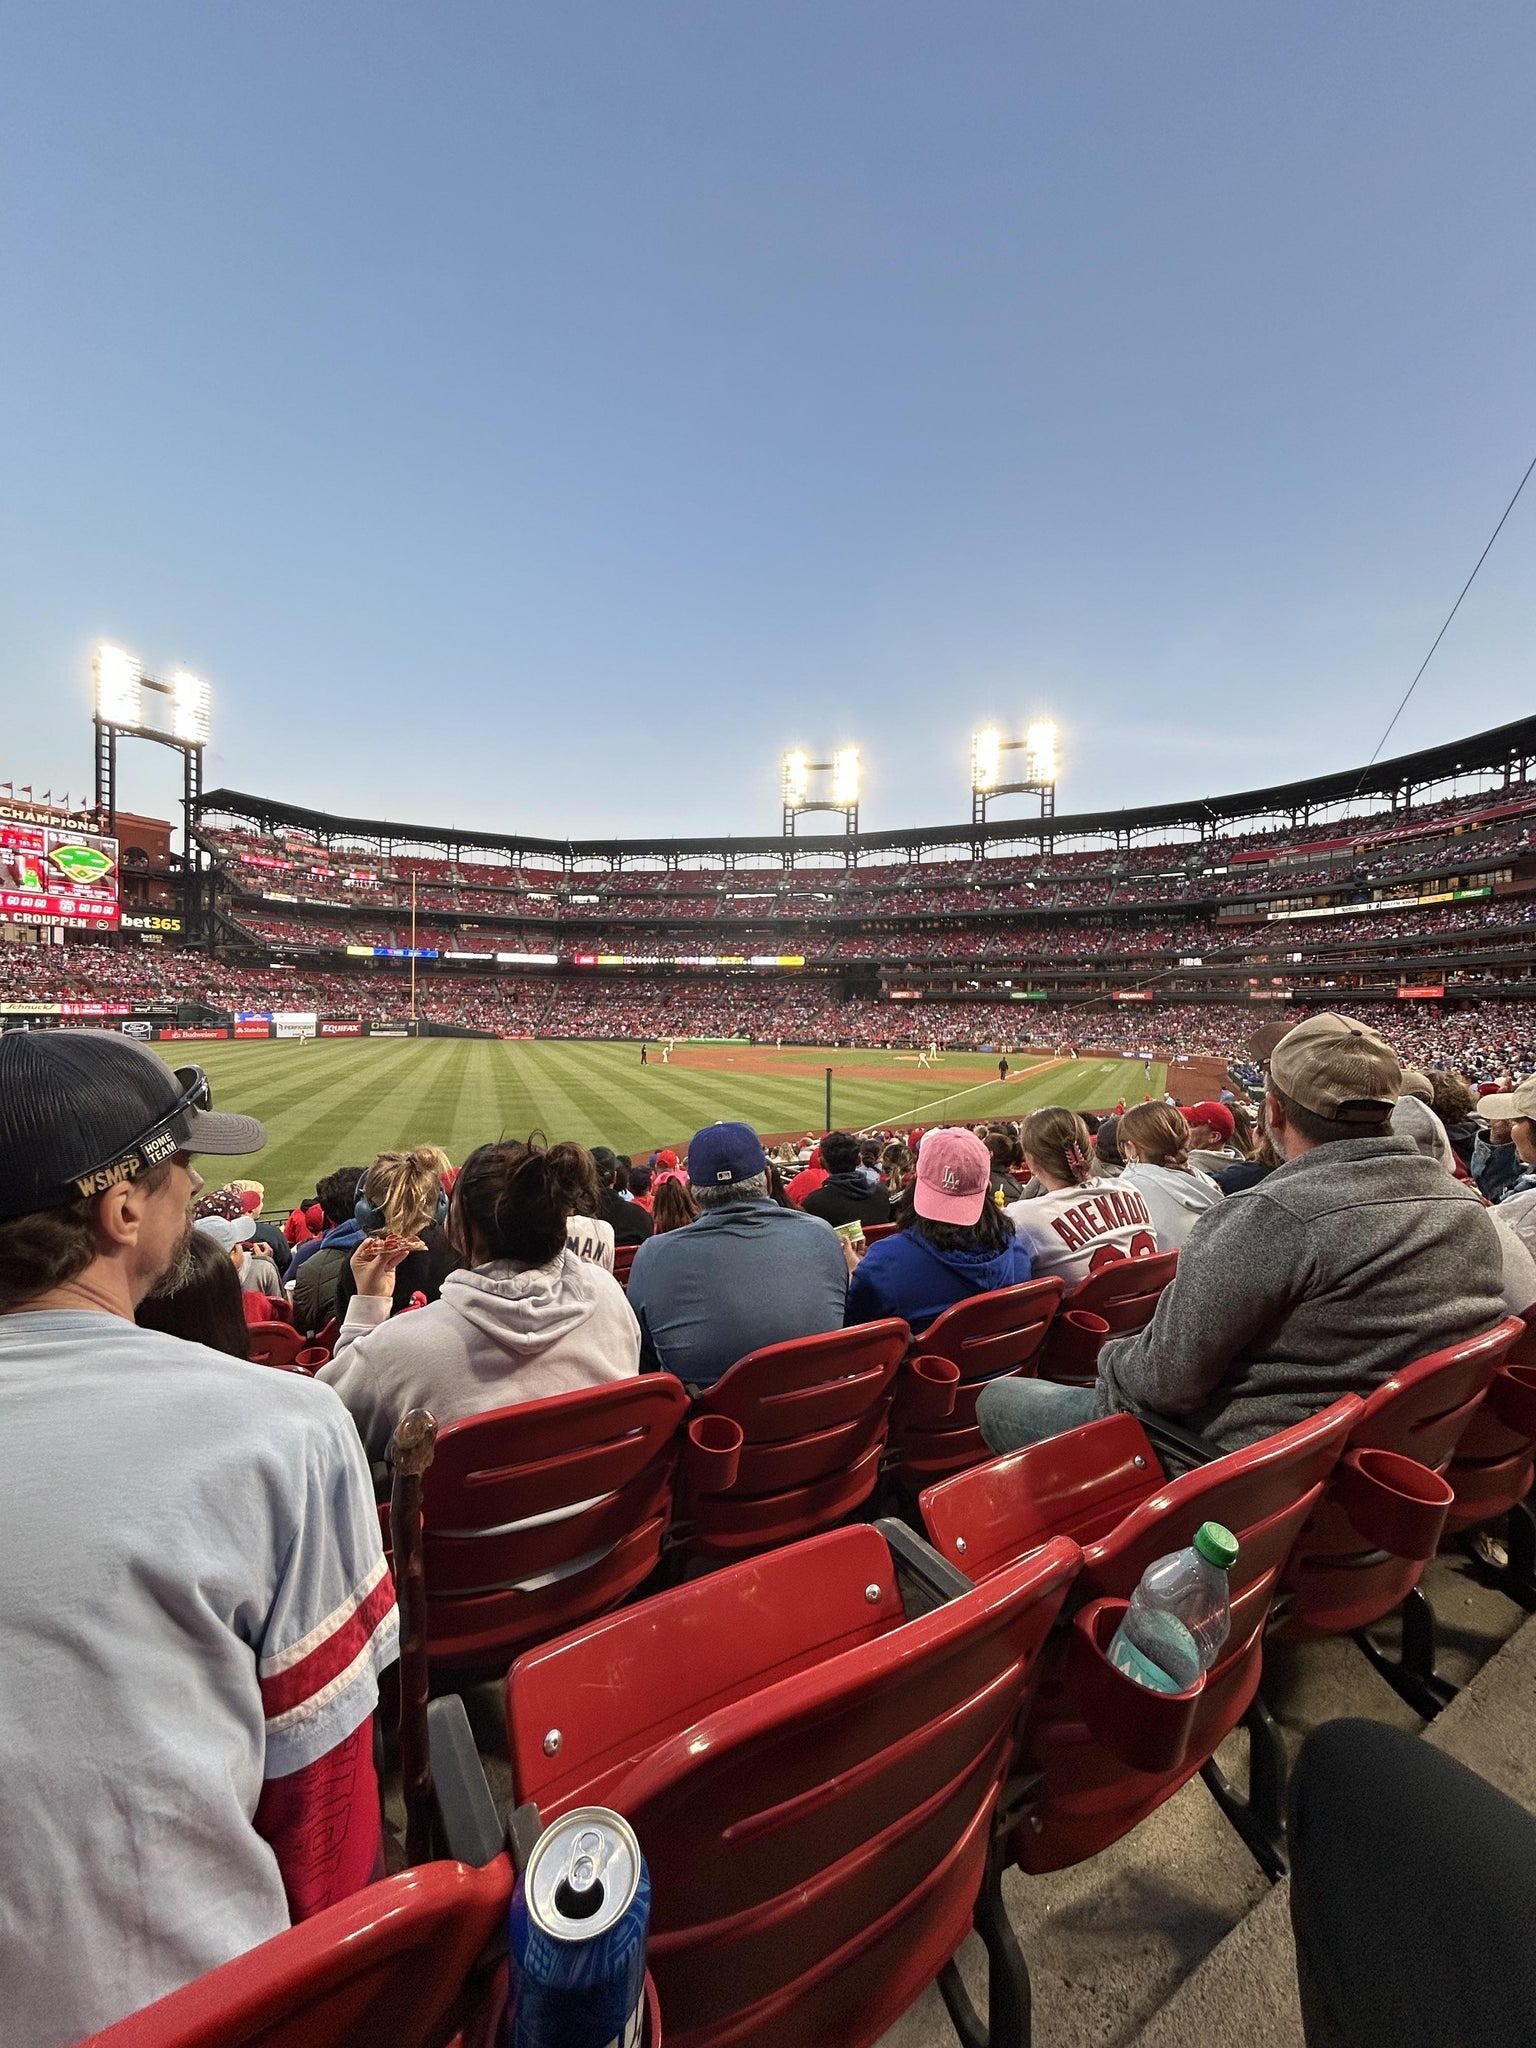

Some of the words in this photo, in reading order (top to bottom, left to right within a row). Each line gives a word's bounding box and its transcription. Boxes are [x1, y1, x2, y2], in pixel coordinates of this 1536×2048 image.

[0, 806, 100, 833] CHAMPIONS
[13, 912, 87, 928] CROUPPEN
[121, 913, 181, 931] bet365
[182, 1031, 218, 1039] Budweiser
[322, 1024, 359, 1033] EQUIFAX
[144, 1132, 173, 1155] HOME
[148, 1142, 177, 1163] TEAM
[77, 1158, 140, 1198] WSMFP
[942, 1165, 960, 1190] LA
[1050, 1191, 1150, 1253] ARENADO
[565, 1236, 605, 1261] MAN
